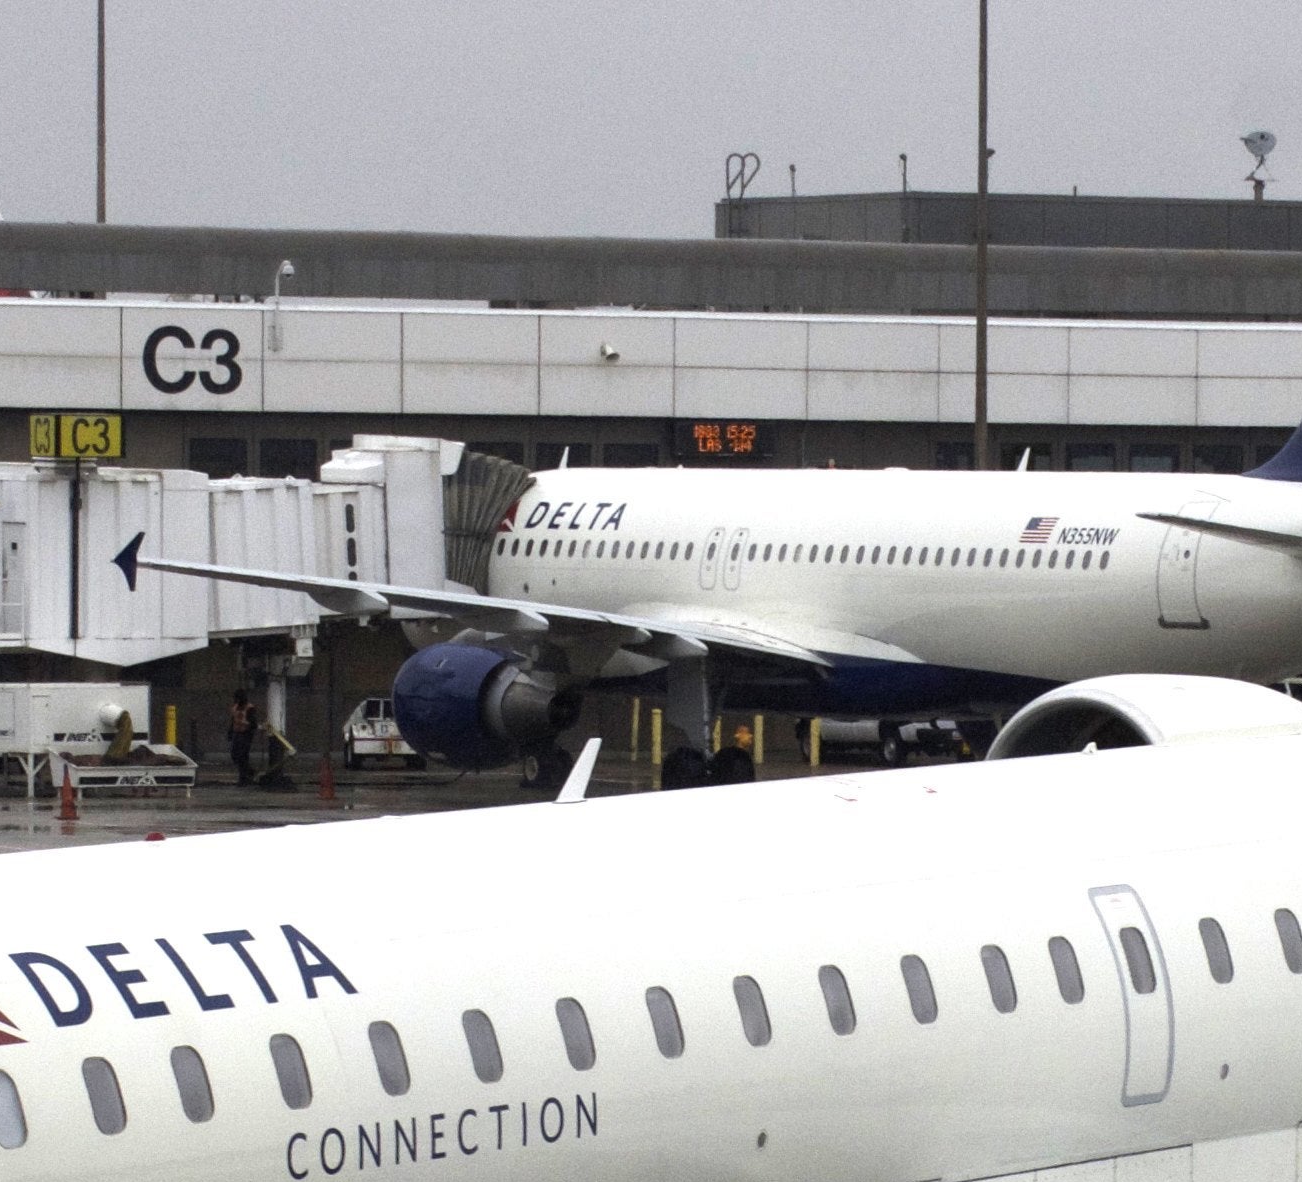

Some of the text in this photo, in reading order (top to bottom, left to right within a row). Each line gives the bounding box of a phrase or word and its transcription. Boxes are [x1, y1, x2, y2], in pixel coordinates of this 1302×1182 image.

[143, 325, 243, 394] C3
[34, 418, 50, 453] C3
[72, 418, 110, 454] C3
[525, 501, 627, 531] DELTA
[1057, 527, 1120, 545] N355NW
[8, 924, 358, 1027] DELTA
[287, 1092, 597, 1180] CONNECTION
